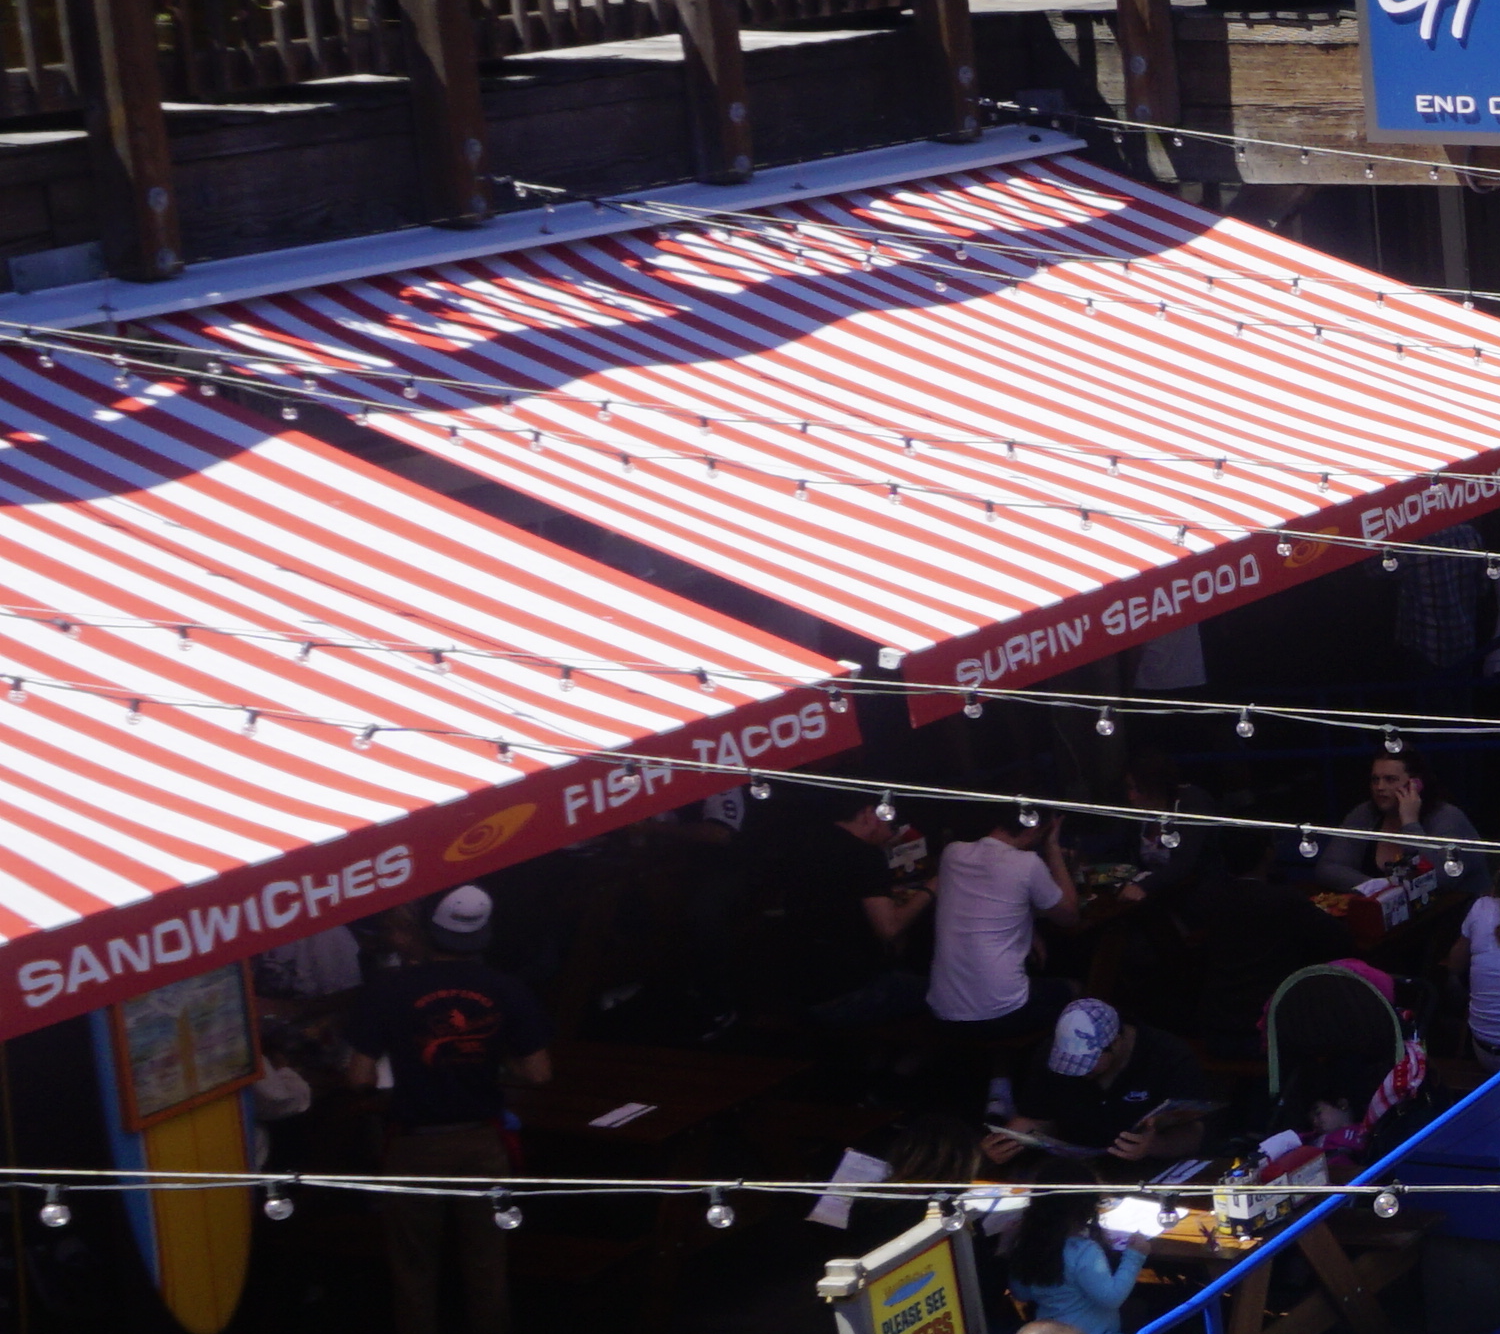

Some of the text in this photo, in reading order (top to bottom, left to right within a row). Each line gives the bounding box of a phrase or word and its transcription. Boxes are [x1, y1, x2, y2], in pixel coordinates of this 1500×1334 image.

[1415, 94, 1476, 114] END
[1101, 551, 1262, 638] SEAFOOD
[15, 702, 829, 1009] SANDWICHES FISH TACOS
[923, 1286, 948, 1317] SEE
